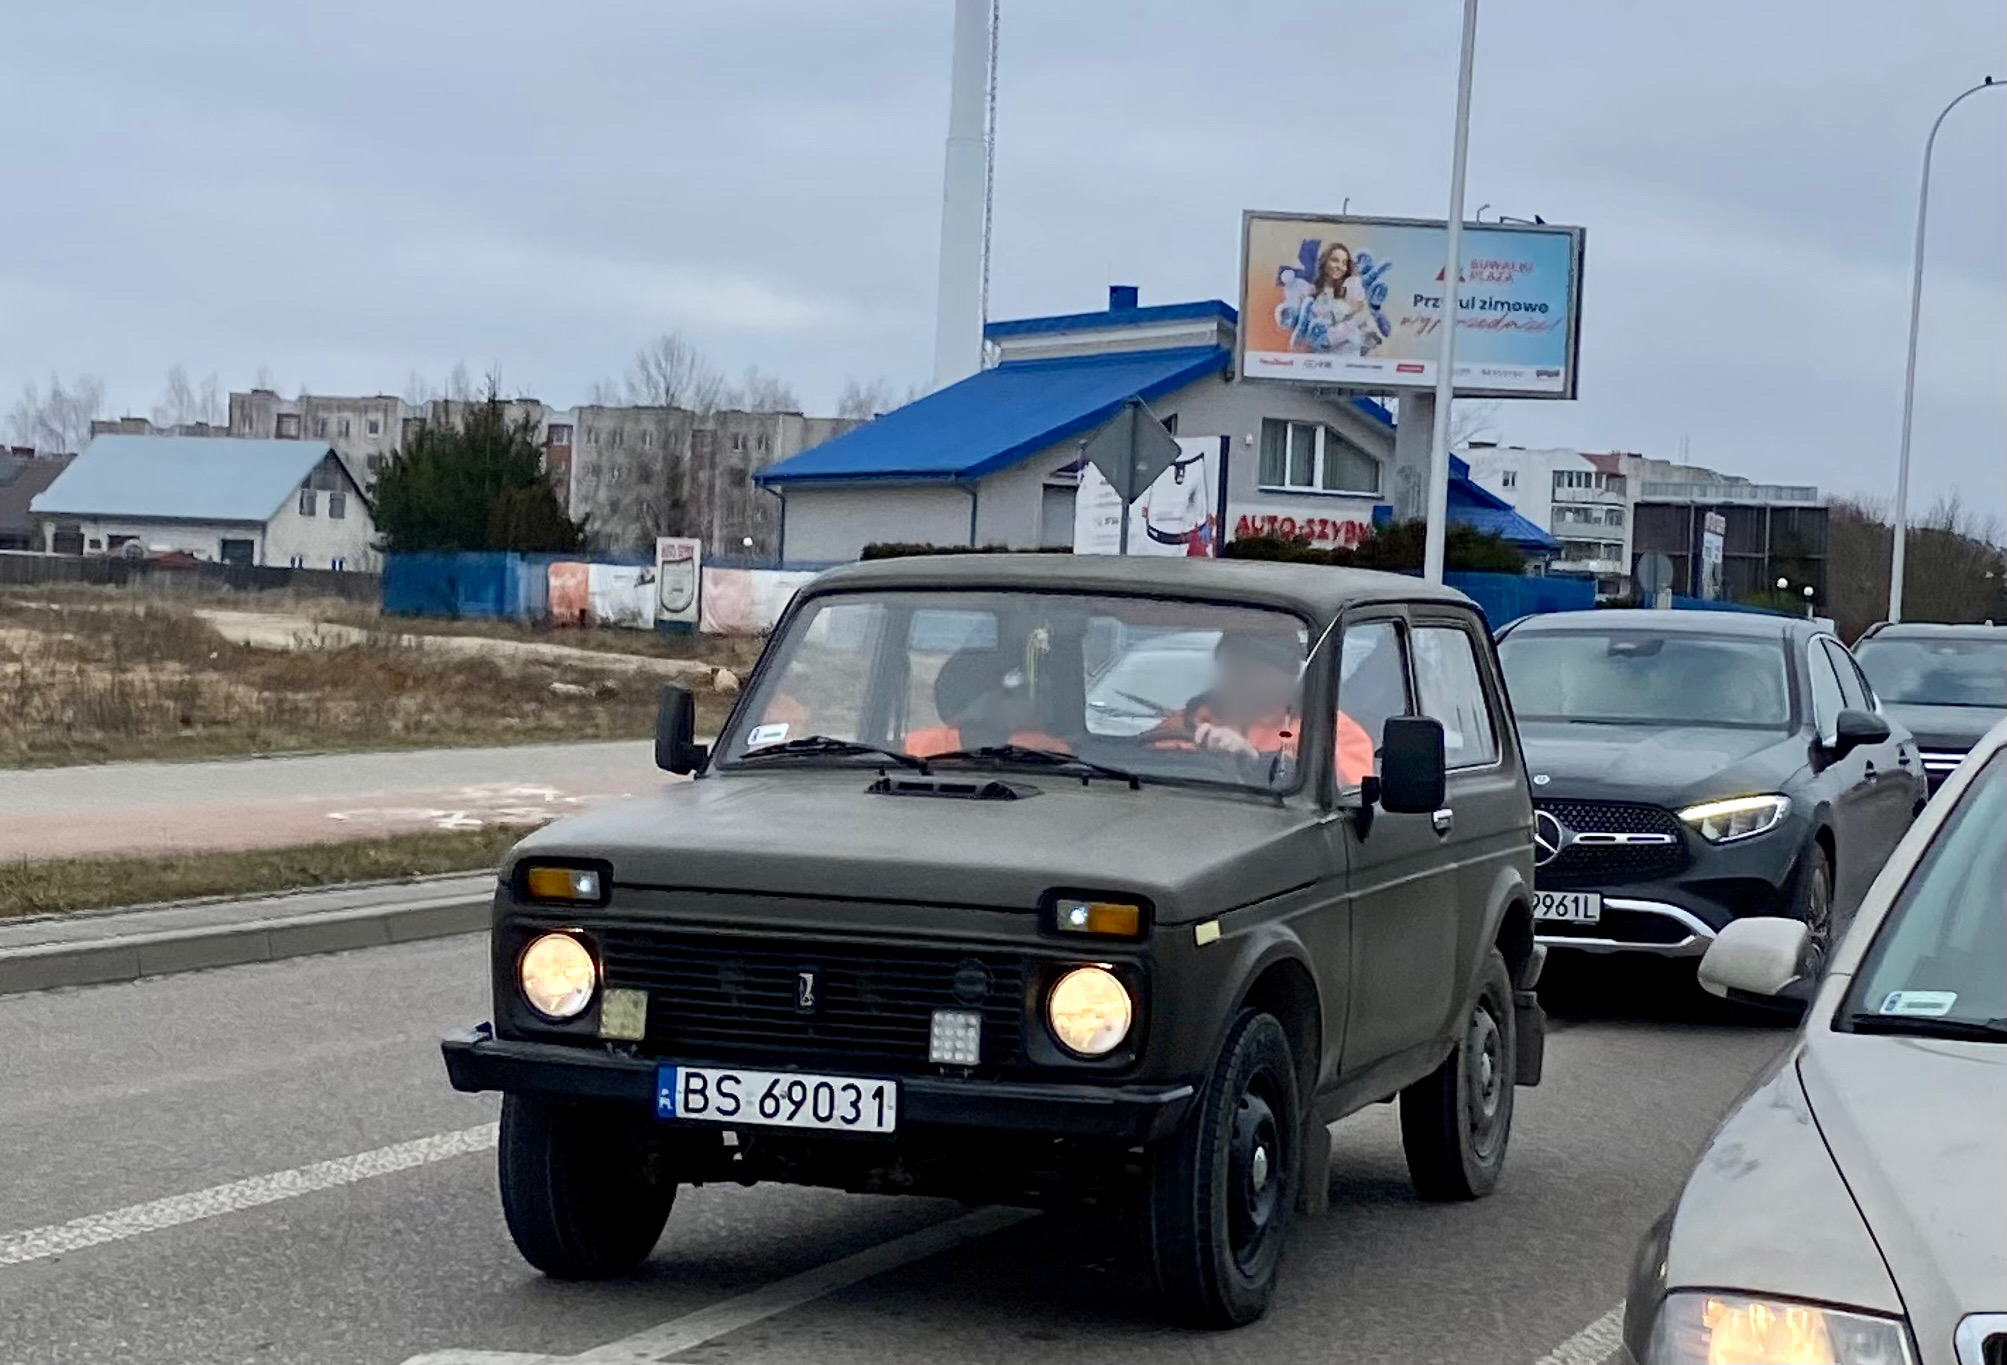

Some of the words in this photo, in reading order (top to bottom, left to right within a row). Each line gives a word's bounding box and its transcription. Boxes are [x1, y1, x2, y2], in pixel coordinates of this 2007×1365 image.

[1413, 294, 1476, 310] Przul
[1479, 296, 1550, 314] zimowe
[683, 1071, 742, 1116] BS
[758, 1078, 885, 1128] 69031
